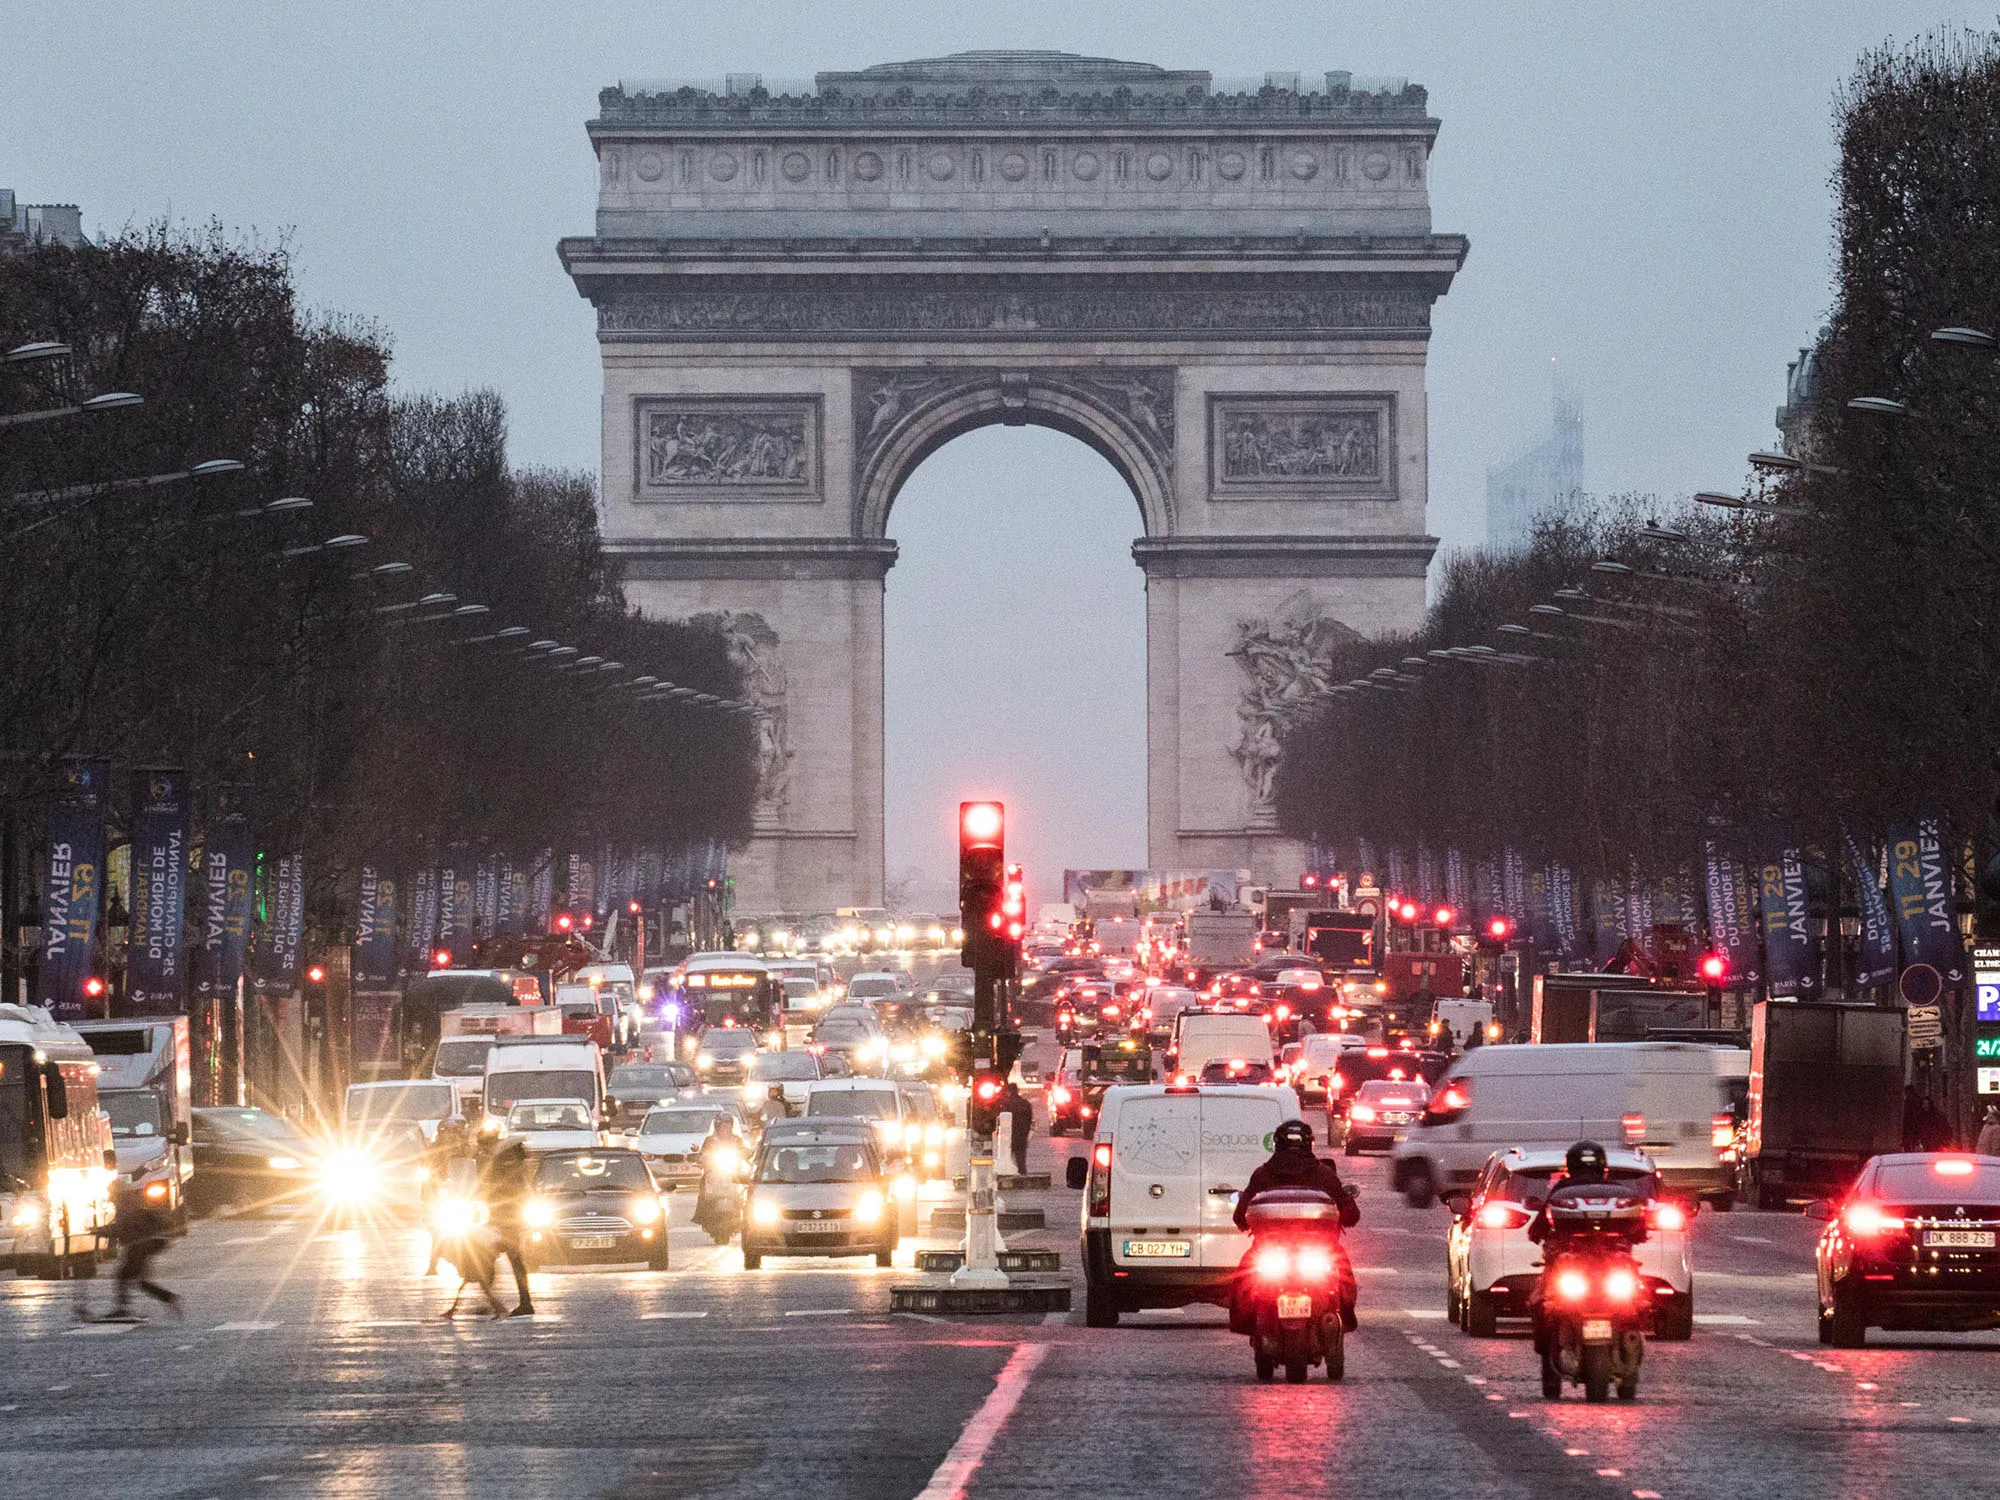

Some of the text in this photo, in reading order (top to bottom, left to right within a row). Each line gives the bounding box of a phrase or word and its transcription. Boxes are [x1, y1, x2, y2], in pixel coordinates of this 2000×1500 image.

[1562, 868, 1570, 881] DE
[1895, 840, 1925, 920] 11 29
[1919, 819, 1951, 932] JANVIER
[1563, 884, 1572, 922] MONDE
[1722, 874, 1735, 923] MONDE
[1763, 865, 1787, 933] 11 29
[1729, 927, 1740, 946] DU
[1201, 1131, 1258, 1149] Sequoia
